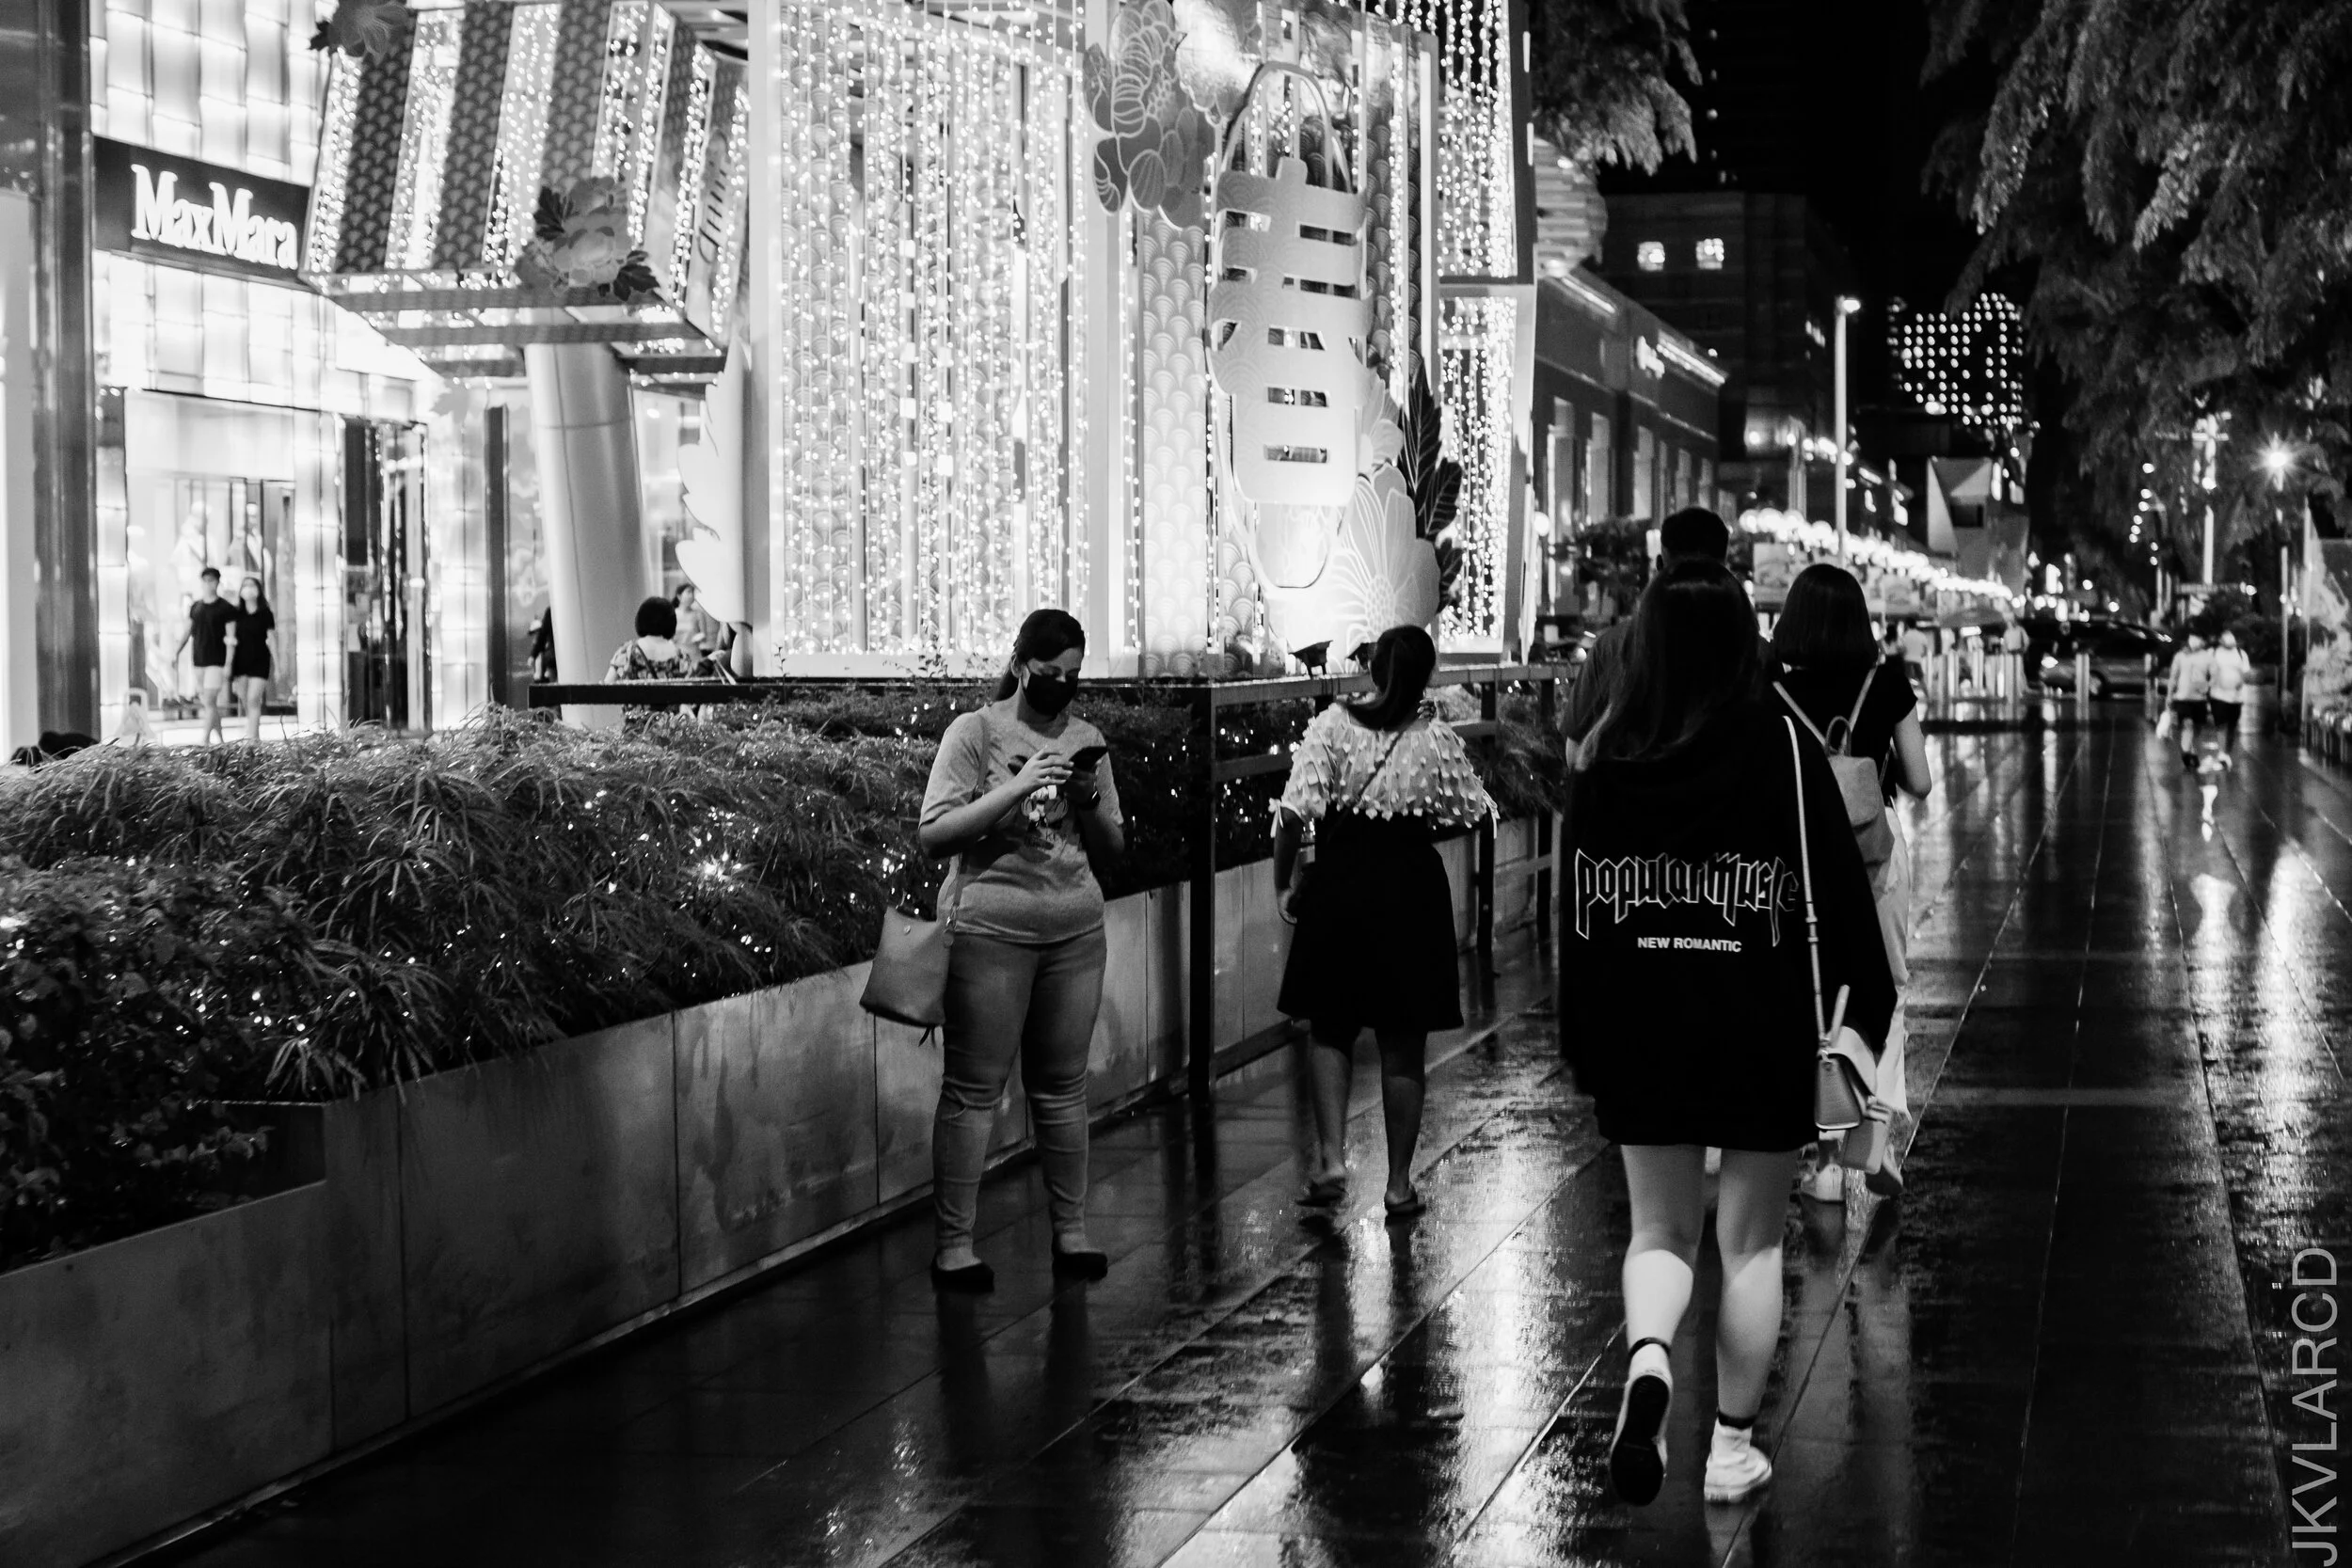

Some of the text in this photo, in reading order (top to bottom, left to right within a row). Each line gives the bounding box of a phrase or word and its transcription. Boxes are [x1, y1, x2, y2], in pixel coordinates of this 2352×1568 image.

[131, 164, 298, 270] MaxMara
[1637, 937, 1742, 952] NEW ROMANTIC
